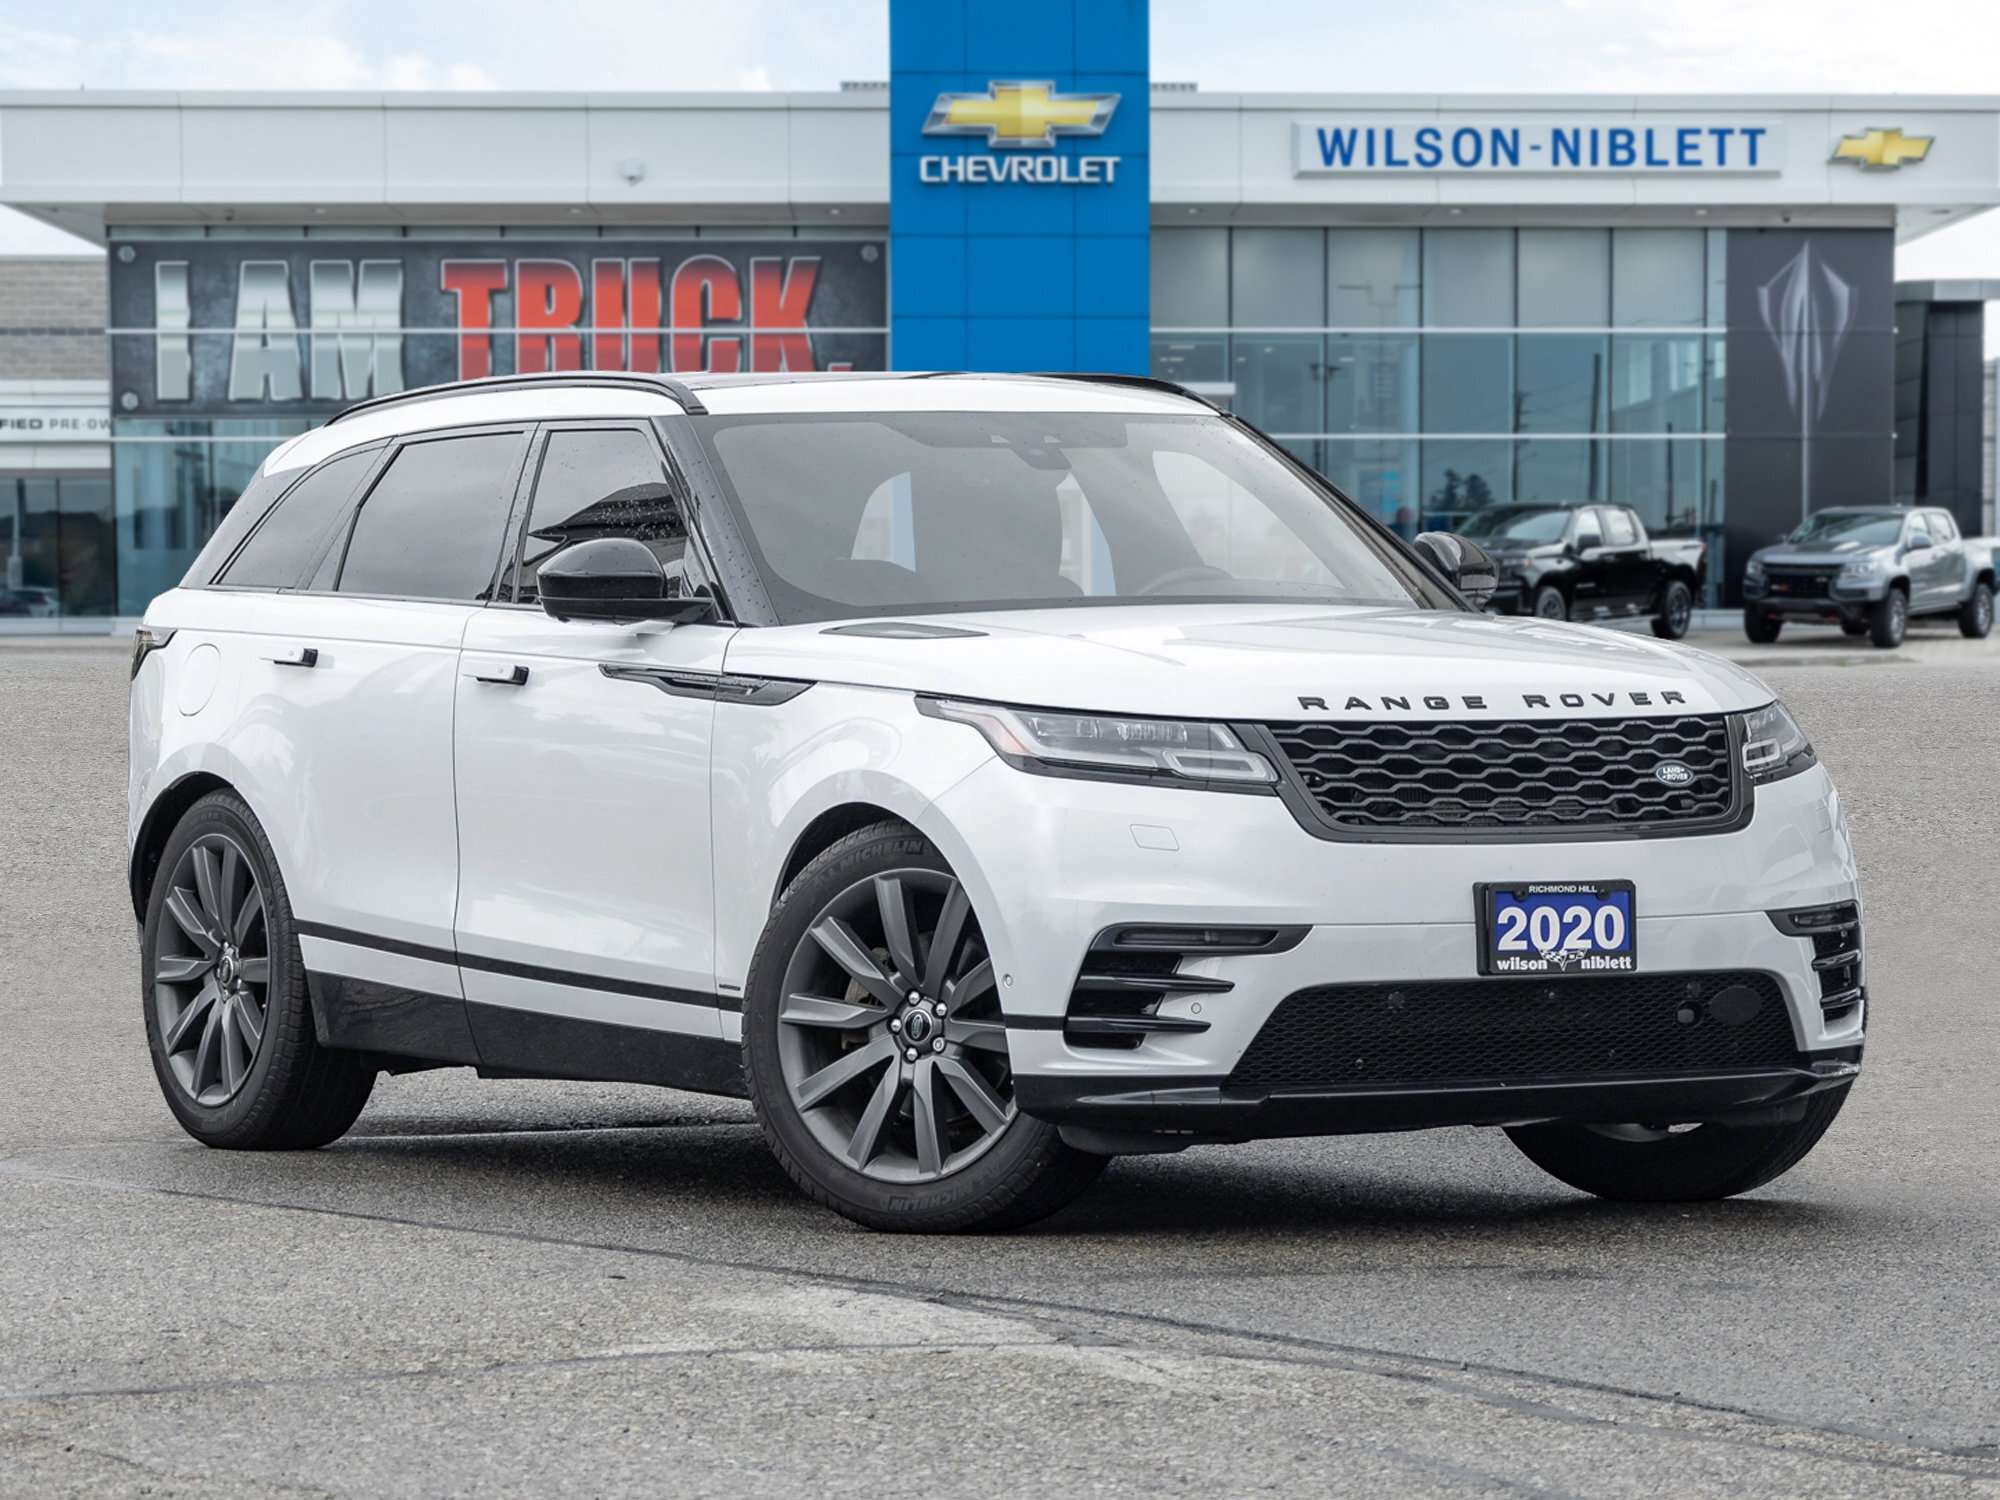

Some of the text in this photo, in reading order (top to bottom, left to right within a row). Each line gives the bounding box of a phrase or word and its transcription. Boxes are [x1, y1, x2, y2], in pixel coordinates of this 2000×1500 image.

[1316, 127, 1767, 168] WILSON-NIBLETT
[919, 156, 1121, 183] CHEVROLET
[155, 260, 192, 399] I
[228, 260, 403, 400] AM
[1298, 691, 1686, 711] RANGE ROVER
[1528, 884, 1598, 894] RICHMOND HILL
[1497, 905, 1625, 950] 2020
[1497, 955, 1632, 971] wilson niblett
